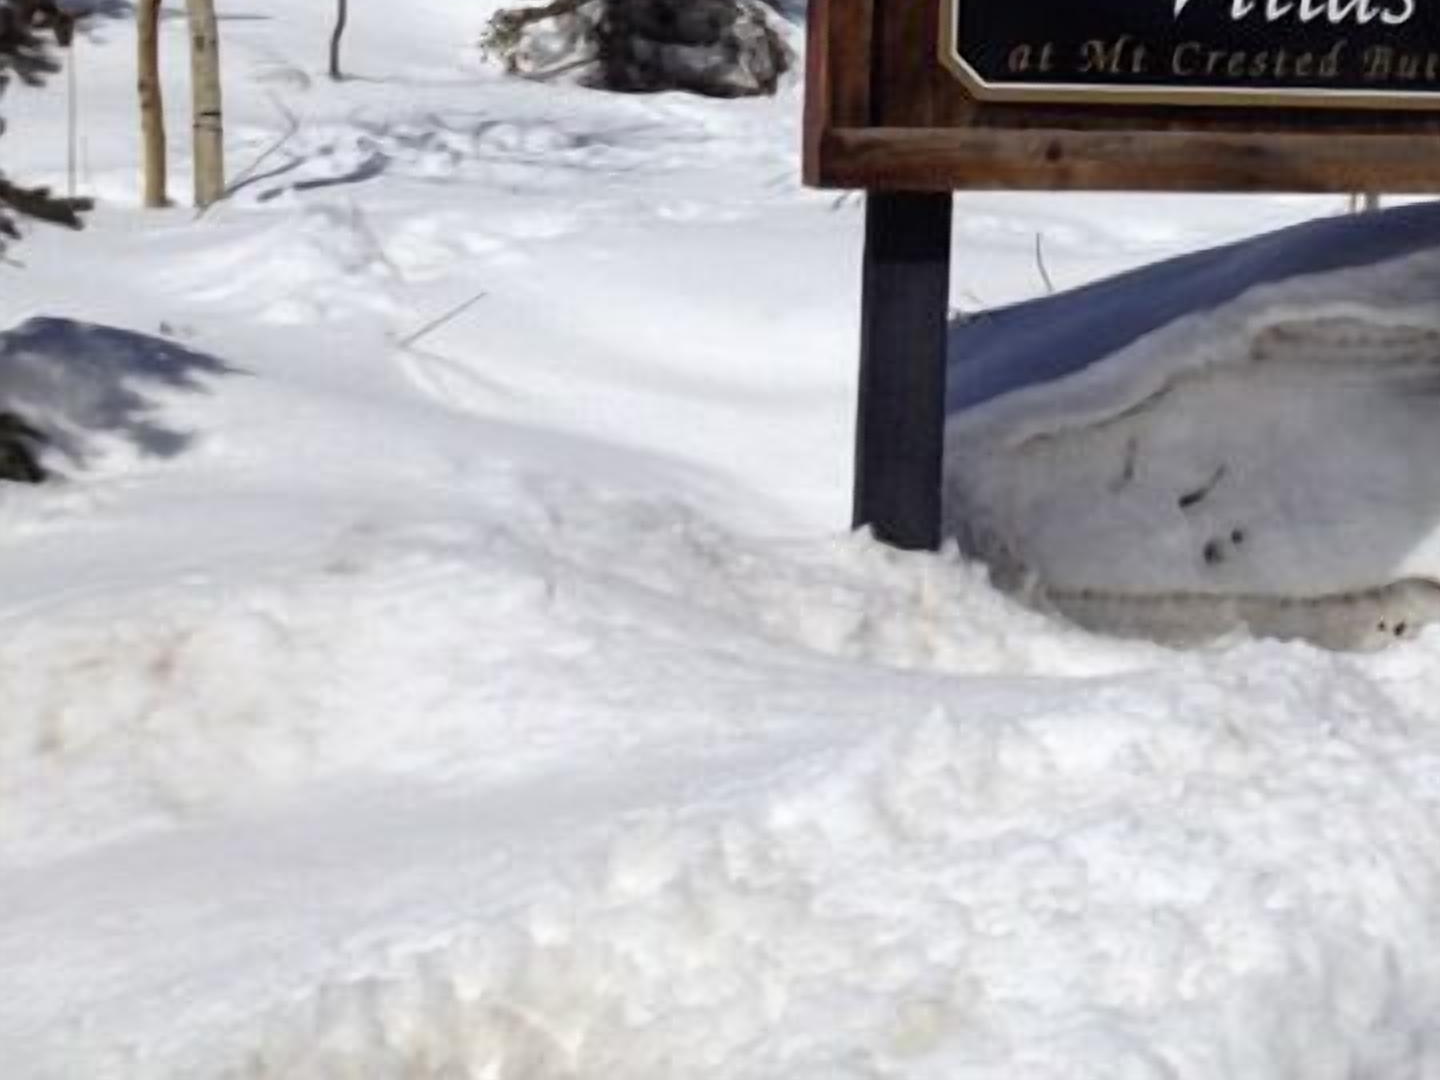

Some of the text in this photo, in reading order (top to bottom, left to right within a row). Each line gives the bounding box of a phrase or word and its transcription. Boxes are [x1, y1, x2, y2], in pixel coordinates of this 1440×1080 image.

[1007, 42, 1054, 73] at
[1080, 35, 1144, 74] Mt
[1171, 40, 1346, 79] Crested
